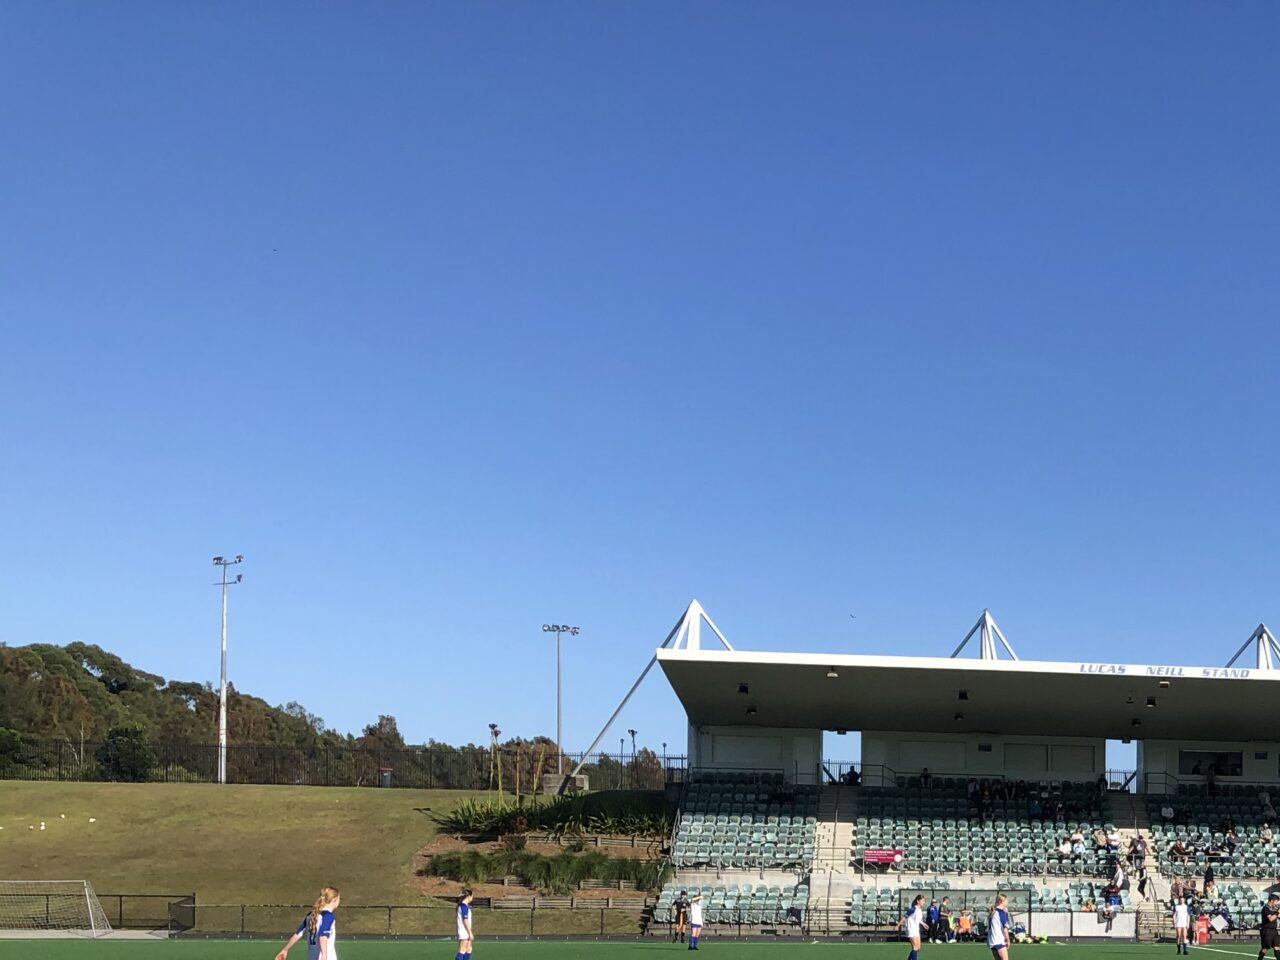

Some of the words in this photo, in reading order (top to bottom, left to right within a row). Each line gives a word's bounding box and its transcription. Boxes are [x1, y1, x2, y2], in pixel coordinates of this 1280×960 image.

[1079, 664, 1126, 674] LUCAS
[1146, 666, 1185, 676] NEILL
[1201, 668, 1250, 678] STAND
